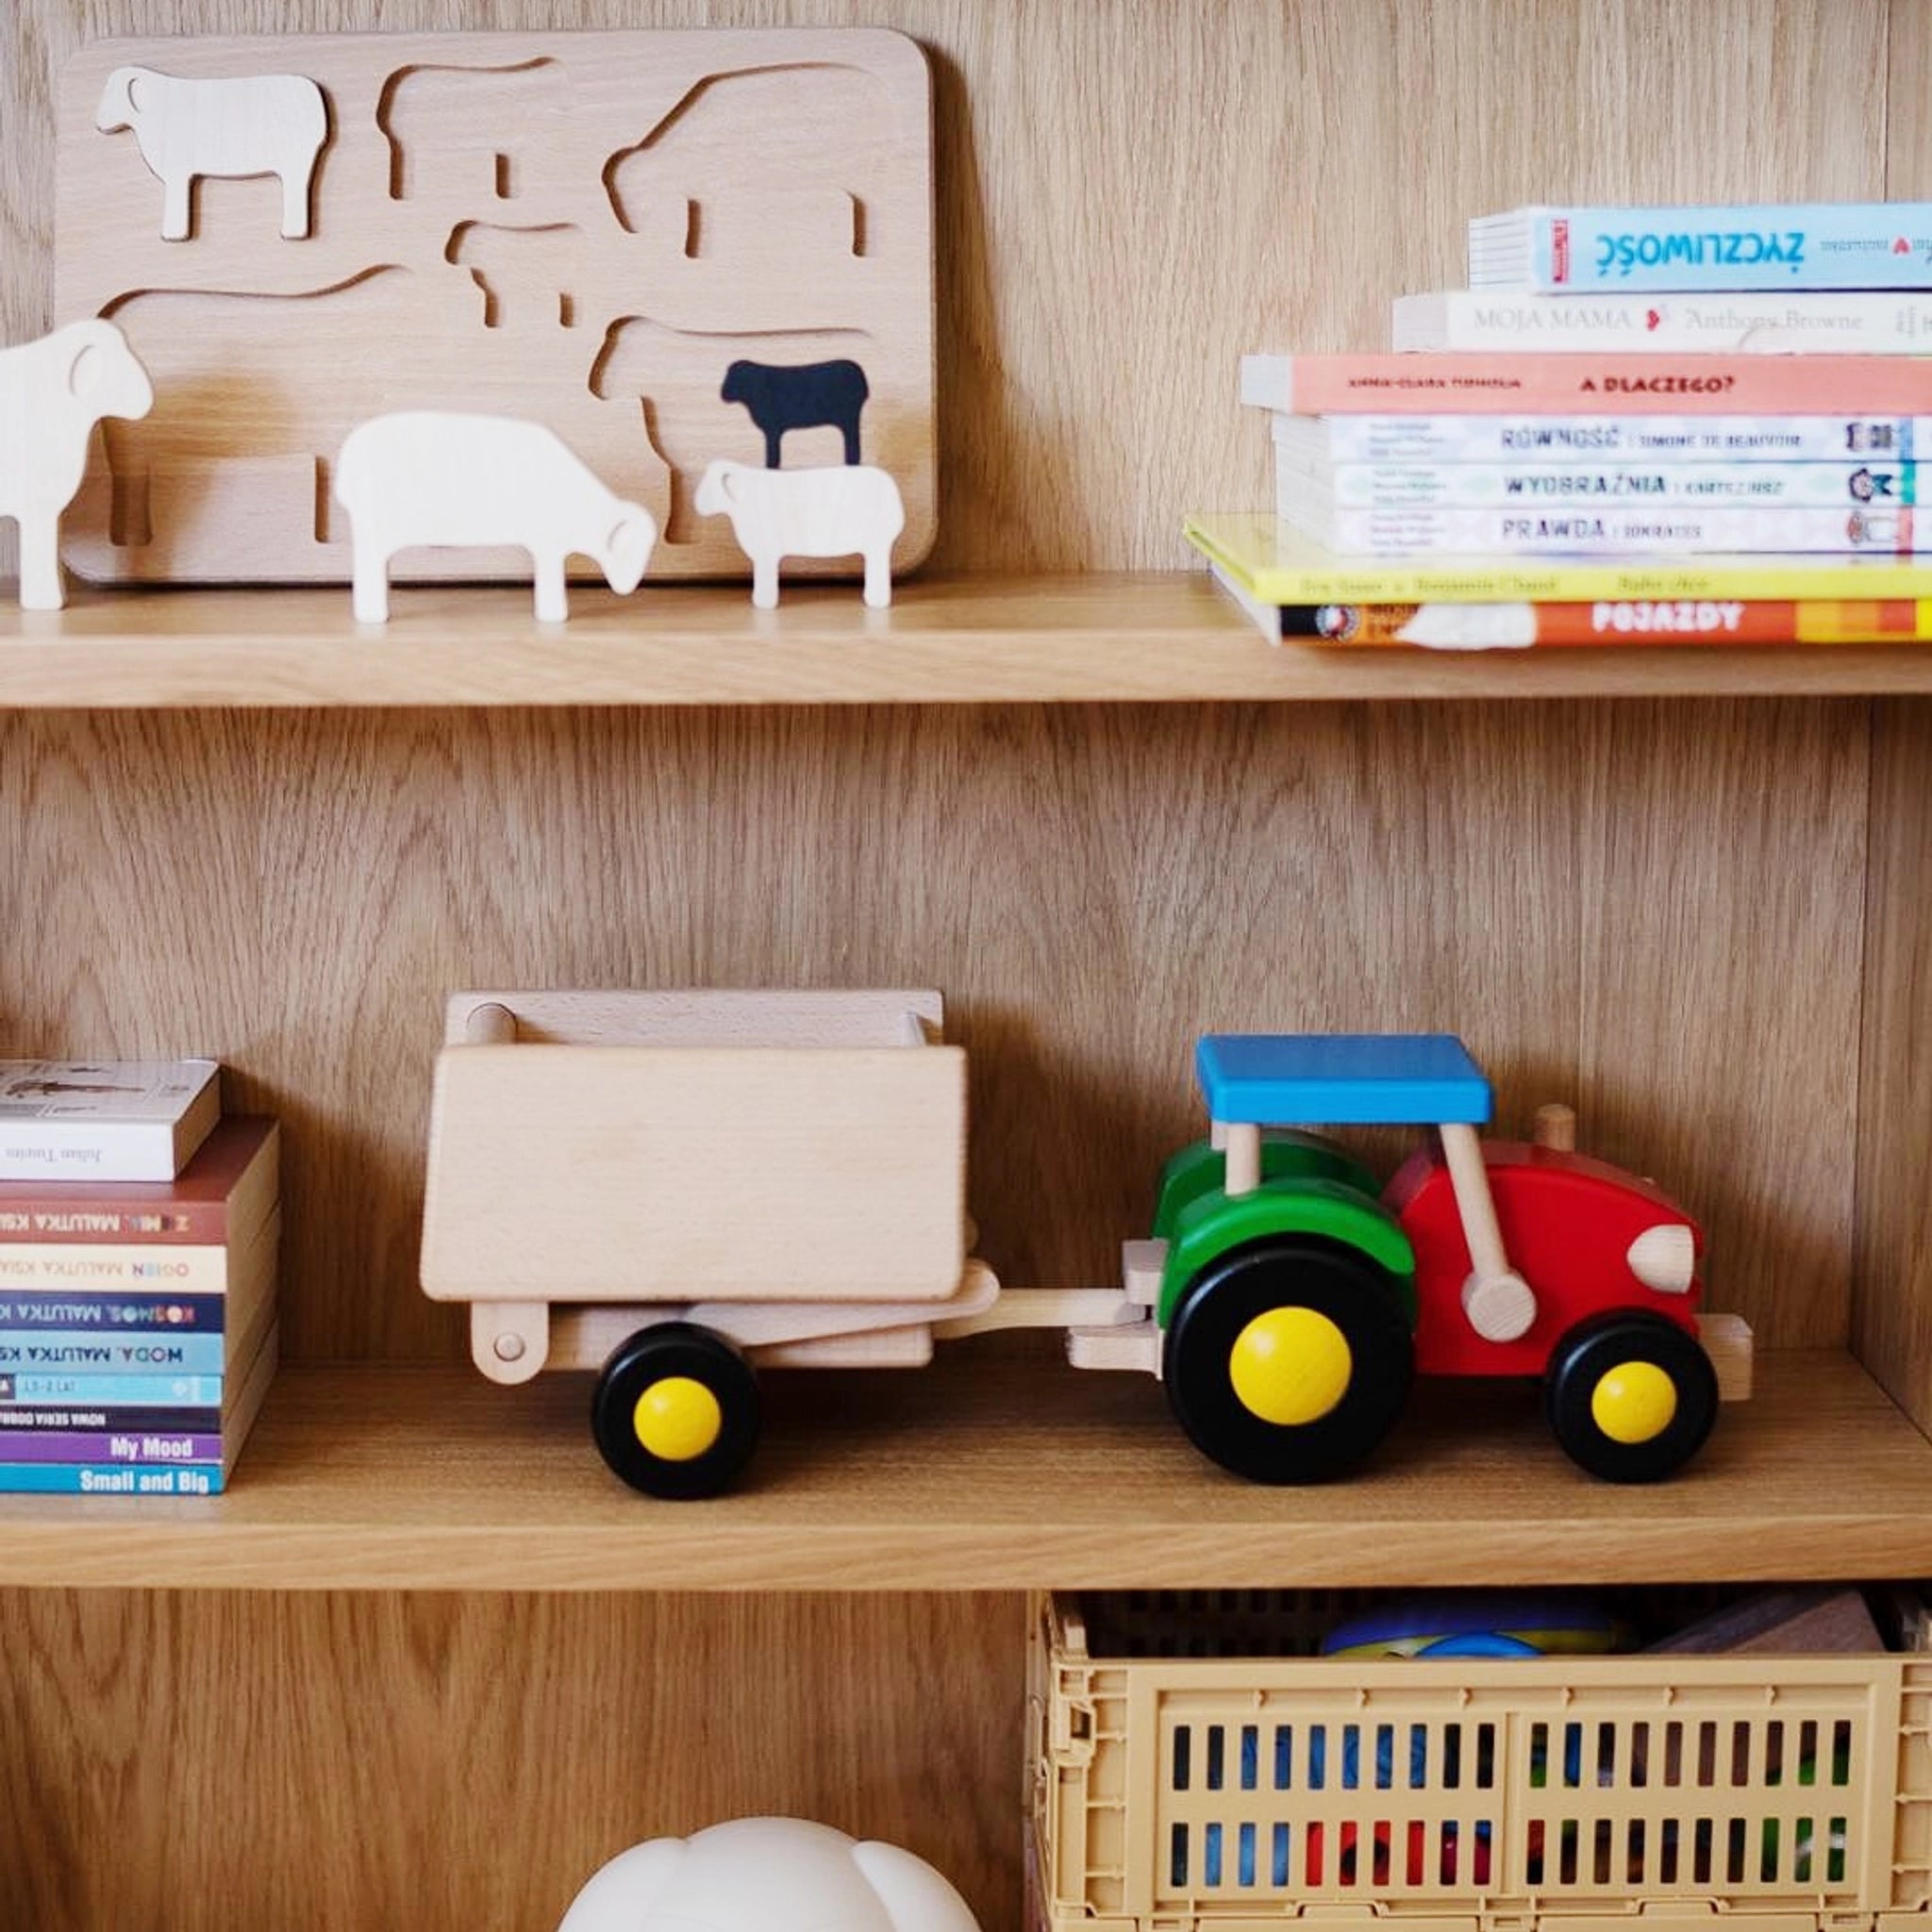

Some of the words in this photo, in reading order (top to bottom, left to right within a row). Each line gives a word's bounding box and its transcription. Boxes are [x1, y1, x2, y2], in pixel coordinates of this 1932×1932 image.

[1596, 232, 1805, 276] ŻYCZLIWOŚĆ
[1474, 309, 1542, 332] MOJA
[1549, 309, 1631, 330] MAMA
[1685, 307, 1777, 332] Anthony
[1785, 311, 1862, 330] Browne
[1579, 377, 1597, 392] A
[1604, 375, 1735, 393] DLACZEGO?
[1501, 426, 1620, 449] RÓWNOŚĆ
[1505, 472, 1666, 496] WYOBRAŹNIA
[1502, 519, 1605, 540] PRAWDA
[1591, 602, 1744, 633] POJAZDY
[60, 1149, 103, 1162] Julian
[35, 1214, 120, 1231] MALUTKA
[43, 1261, 124, 1276] MALUTKA
[18, 1304, 102, 1322] MALUTKA
[28, 1346, 111, 1362] MALUTKA
[72, 1412, 107, 1425] NOWA
[110, 1436, 139, 1460] My
[142, 1437, 193, 1458] Mood
[79, 1470, 135, 1491] Small
[140, 1471, 174, 1491] and
[178, 1471, 209, 1494] Big
